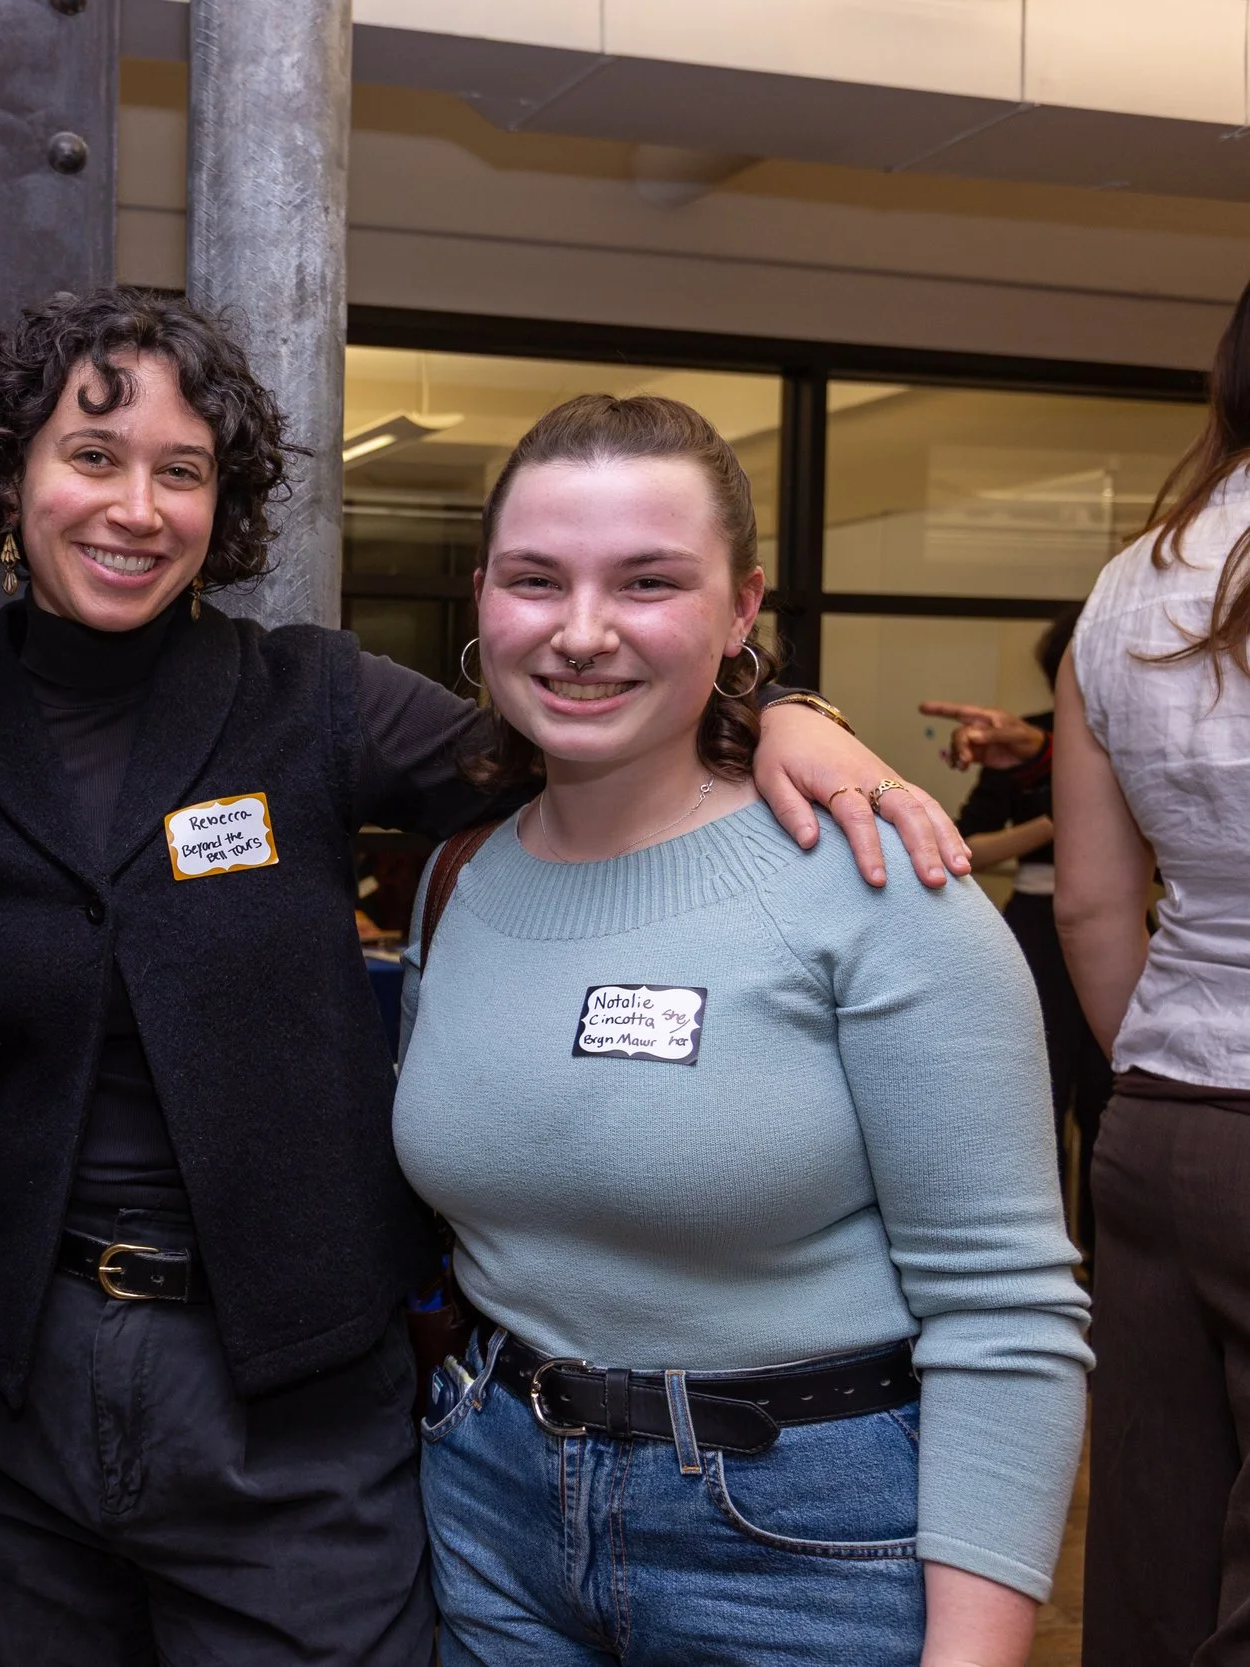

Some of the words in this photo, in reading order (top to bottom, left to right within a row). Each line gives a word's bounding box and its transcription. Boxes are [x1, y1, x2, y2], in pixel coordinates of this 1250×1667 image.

[188, 810, 252, 831] Rebecca
[181, 835, 223, 859] Beyond
[224, 831, 245, 844] the
[593, 992, 654, 1010] Natalie
[589, 1012, 655, 1029] Cincotta
[616, 1033, 658, 1047] Mawr
